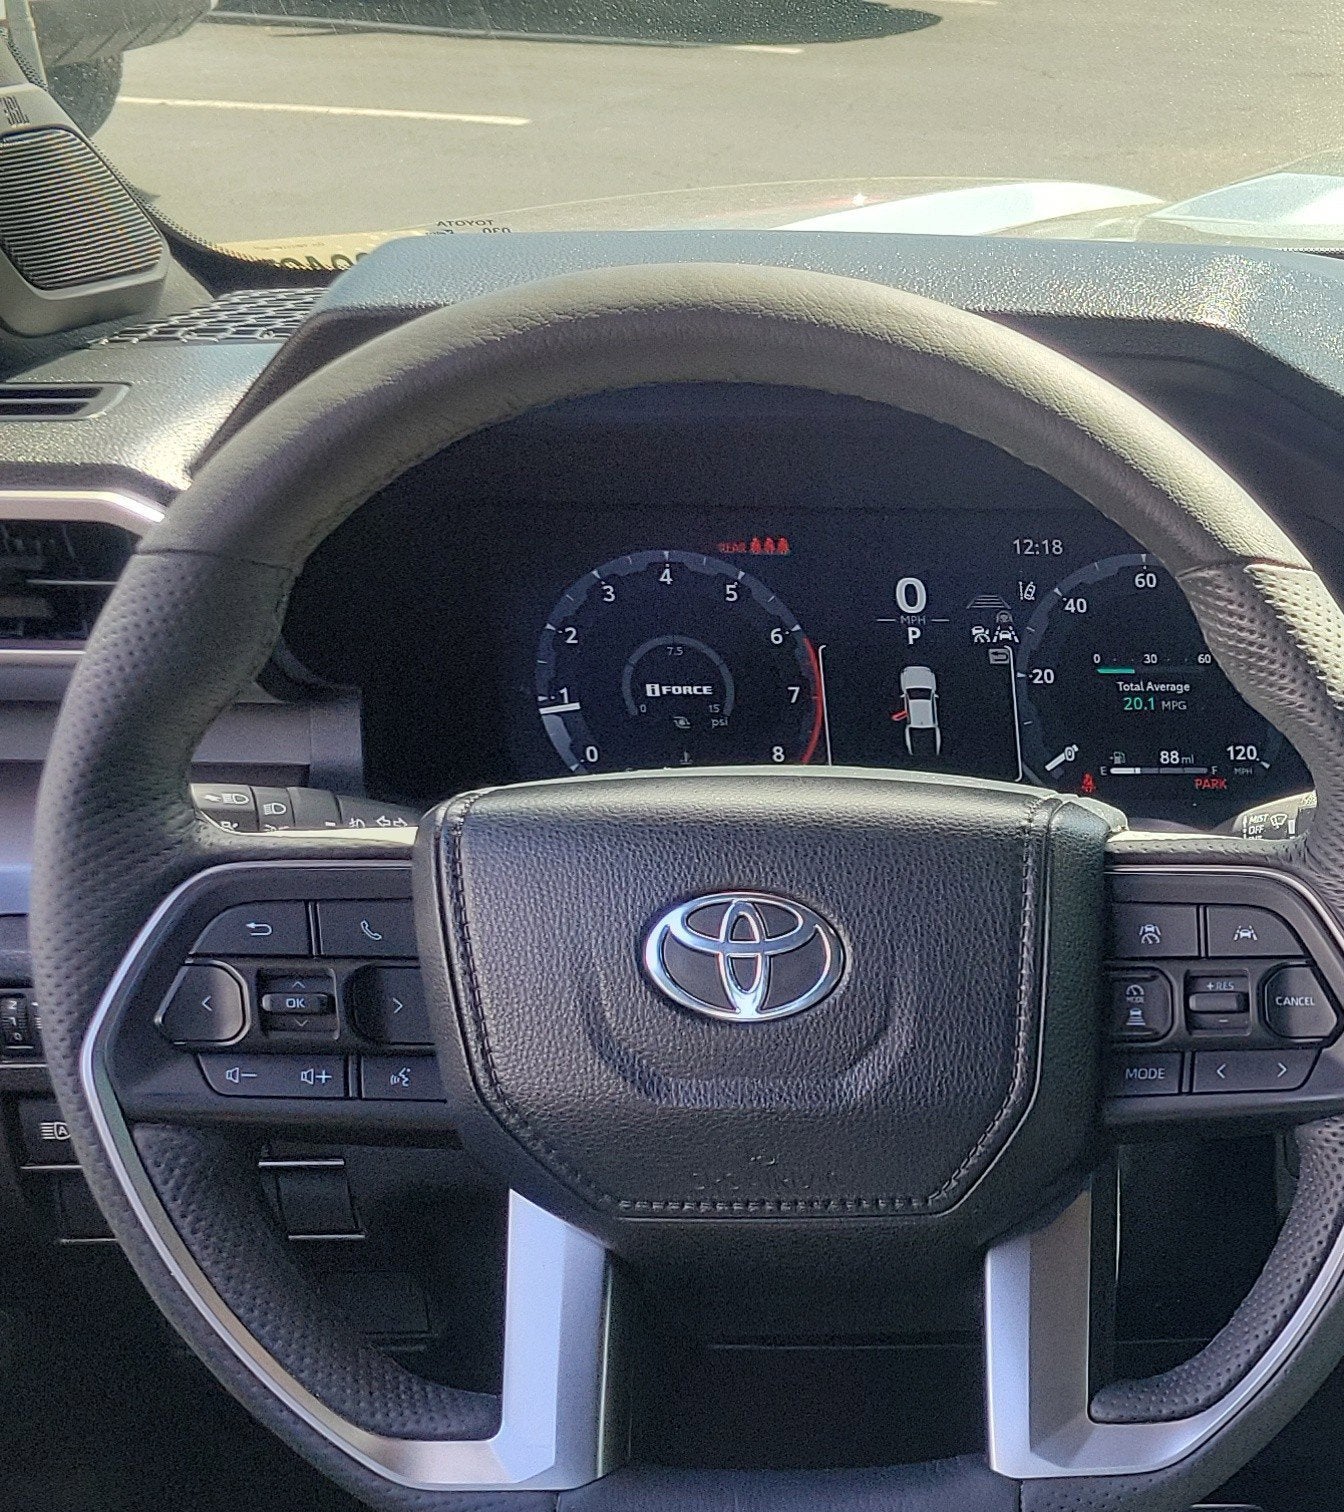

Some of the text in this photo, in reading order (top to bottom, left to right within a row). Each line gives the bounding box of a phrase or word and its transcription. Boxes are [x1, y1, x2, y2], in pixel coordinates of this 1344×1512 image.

[1013, 539, 1064, 555] 12:18
[659, 568, 673, 585] 4
[1134, 573, 1157, 588] 60
[603, 585, 616, 602] 3
[725, 584, 738, 602] 5
[896, 577, 927, 614] 0
[1064, 598, 1087, 614] 40
[900, 616, 926, 625] MPH
[565, 627, 578, 644] 2
[770, 628, 783, 645] 6
[907, 627, 921, 645] P
[666, 646, 684, 656] 7.5
[1093, 653, 1212, 665] 0 30 60
[1032, 669, 1055, 684] 20
[558, 687, 571, 704] 1
[787, 687, 800, 703] 7
[1117, 681, 1191, 696] Total Average
[640, 704, 720, 713] 0 15
[1123, 697, 1187, 711] 20.1 MPG
[711, 717, 729, 729] psi
[586, 746, 599, 763] 0
[772, 746, 785, 763] 8
[1160, 750, 1180, 764] 88
[1226, 745, 1258, 761] 120
[1100, 765, 1219, 776] E F
[1234, 767, 1253, 776] MPH
[1194, 778, 1227, 790] PARK
[285, 997, 306, 1009] OK
[1275, 995, 1316, 1007] CANCEL
[1125, 1067, 1166, 1080] MODE
